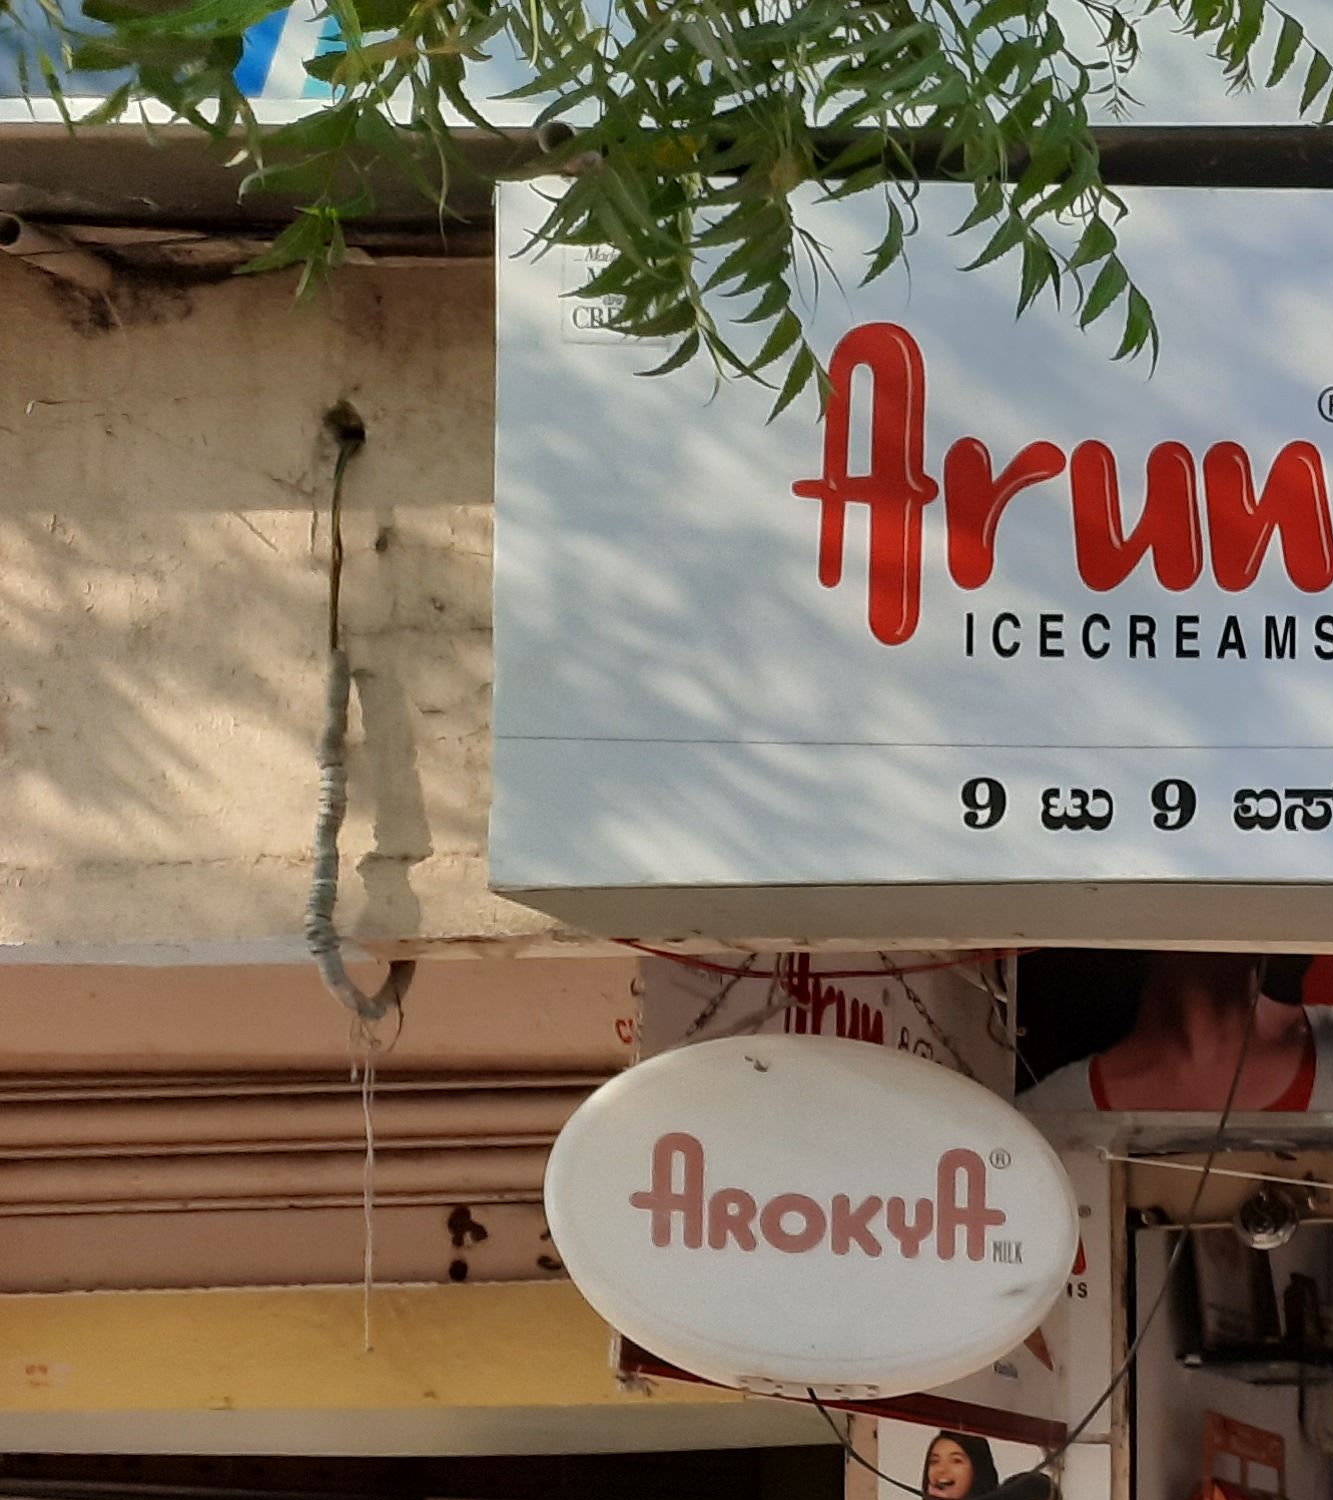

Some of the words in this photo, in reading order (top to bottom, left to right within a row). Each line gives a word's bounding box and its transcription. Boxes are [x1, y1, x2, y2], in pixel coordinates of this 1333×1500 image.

[959, 777, 1007, 832] 9
[1040, 786, 1115, 833] ಟು
[1152, 777, 1197, 832] 9
[991, 1240, 1024, 1265] MILK
